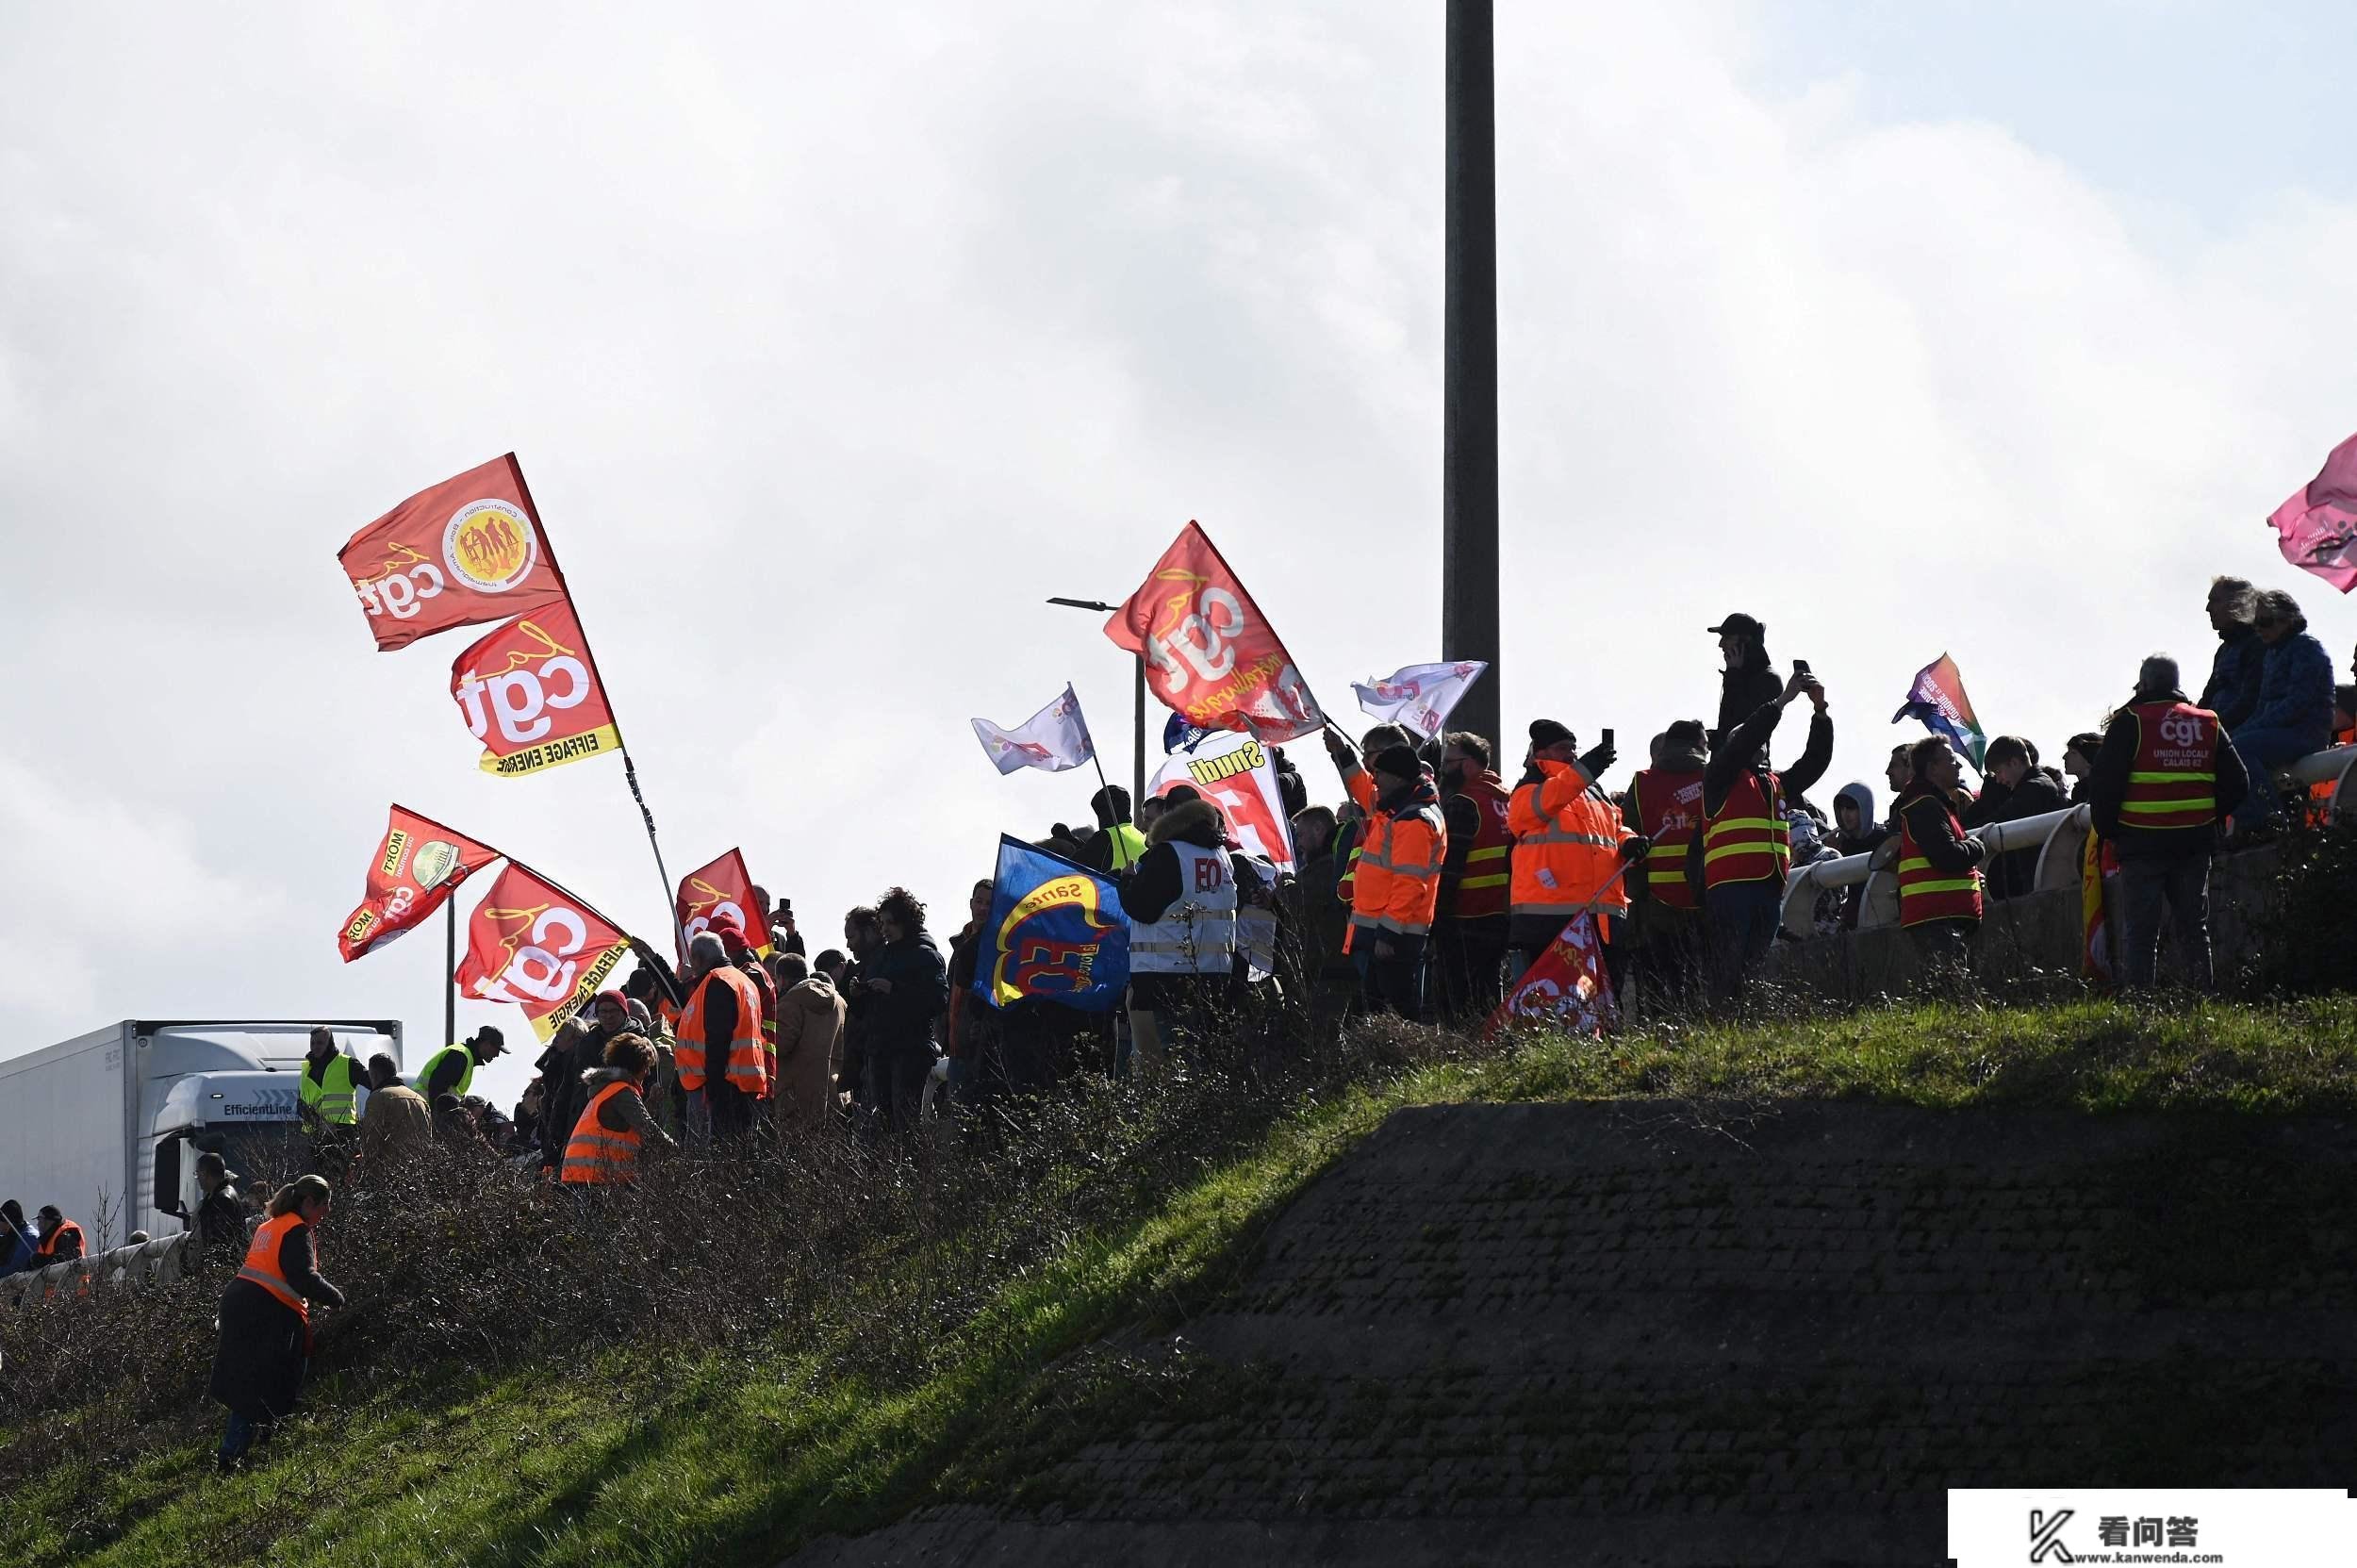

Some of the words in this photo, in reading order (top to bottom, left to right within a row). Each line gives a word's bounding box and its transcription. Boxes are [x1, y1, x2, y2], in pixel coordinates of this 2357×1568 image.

[2160, 717, 2203, 747] cgt
[2153, 749, 2180, 758] UNION
[2182, 749, 2209, 758] LOCALE
[1195, 858, 1221, 888] FO
[224, 1104, 291, 1116] EfficientLine
